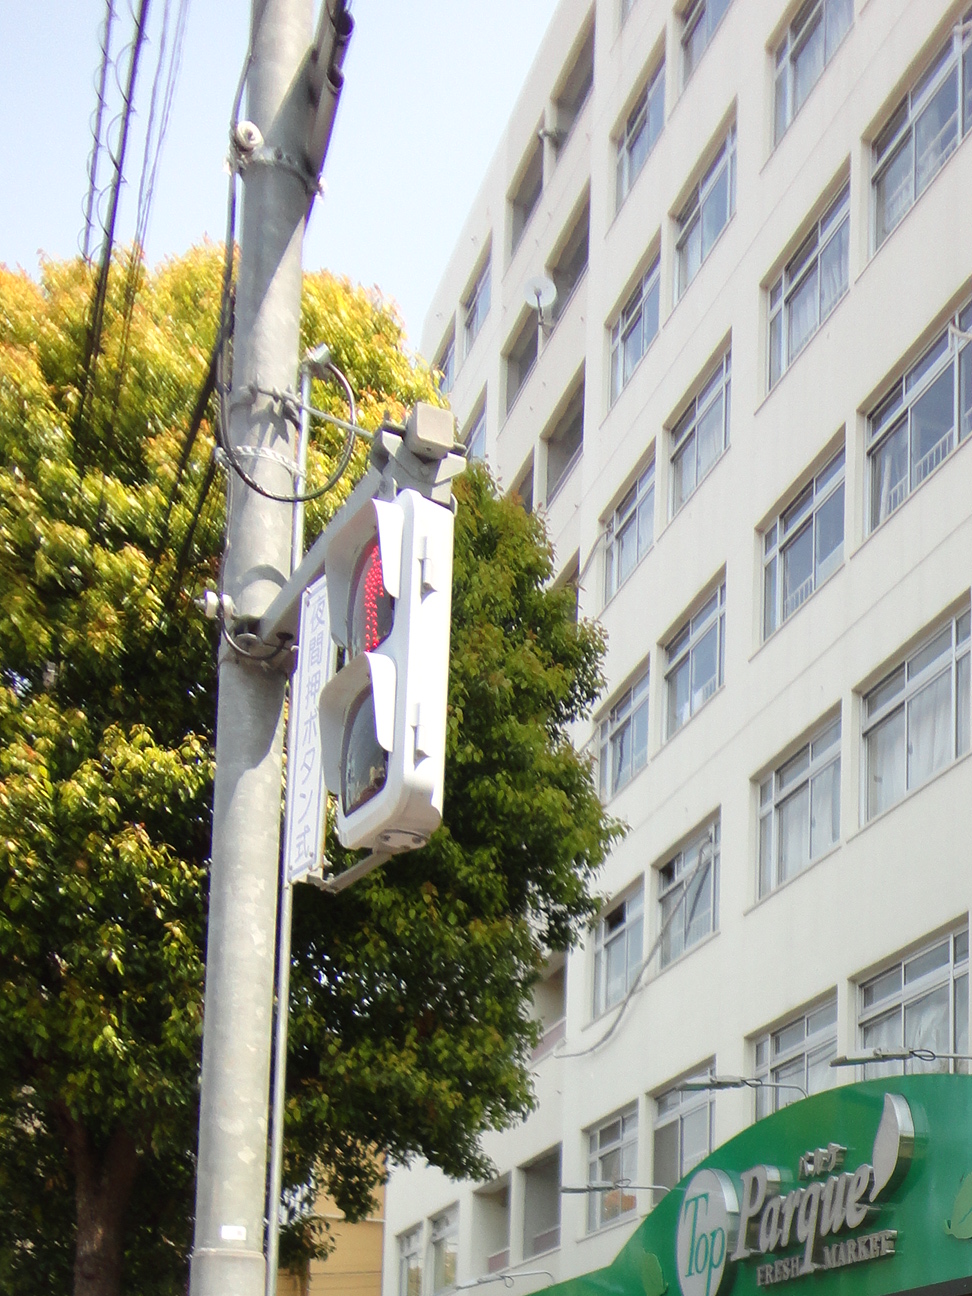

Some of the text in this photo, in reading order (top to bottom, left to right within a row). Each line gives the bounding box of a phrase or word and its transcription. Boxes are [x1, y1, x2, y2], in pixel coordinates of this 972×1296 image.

[296, 597, 326, 860] 夜間押ボタン式
[731, 1163, 876, 1275] Parque
[756, 1229, 898, 1287] FRESH MARKET
